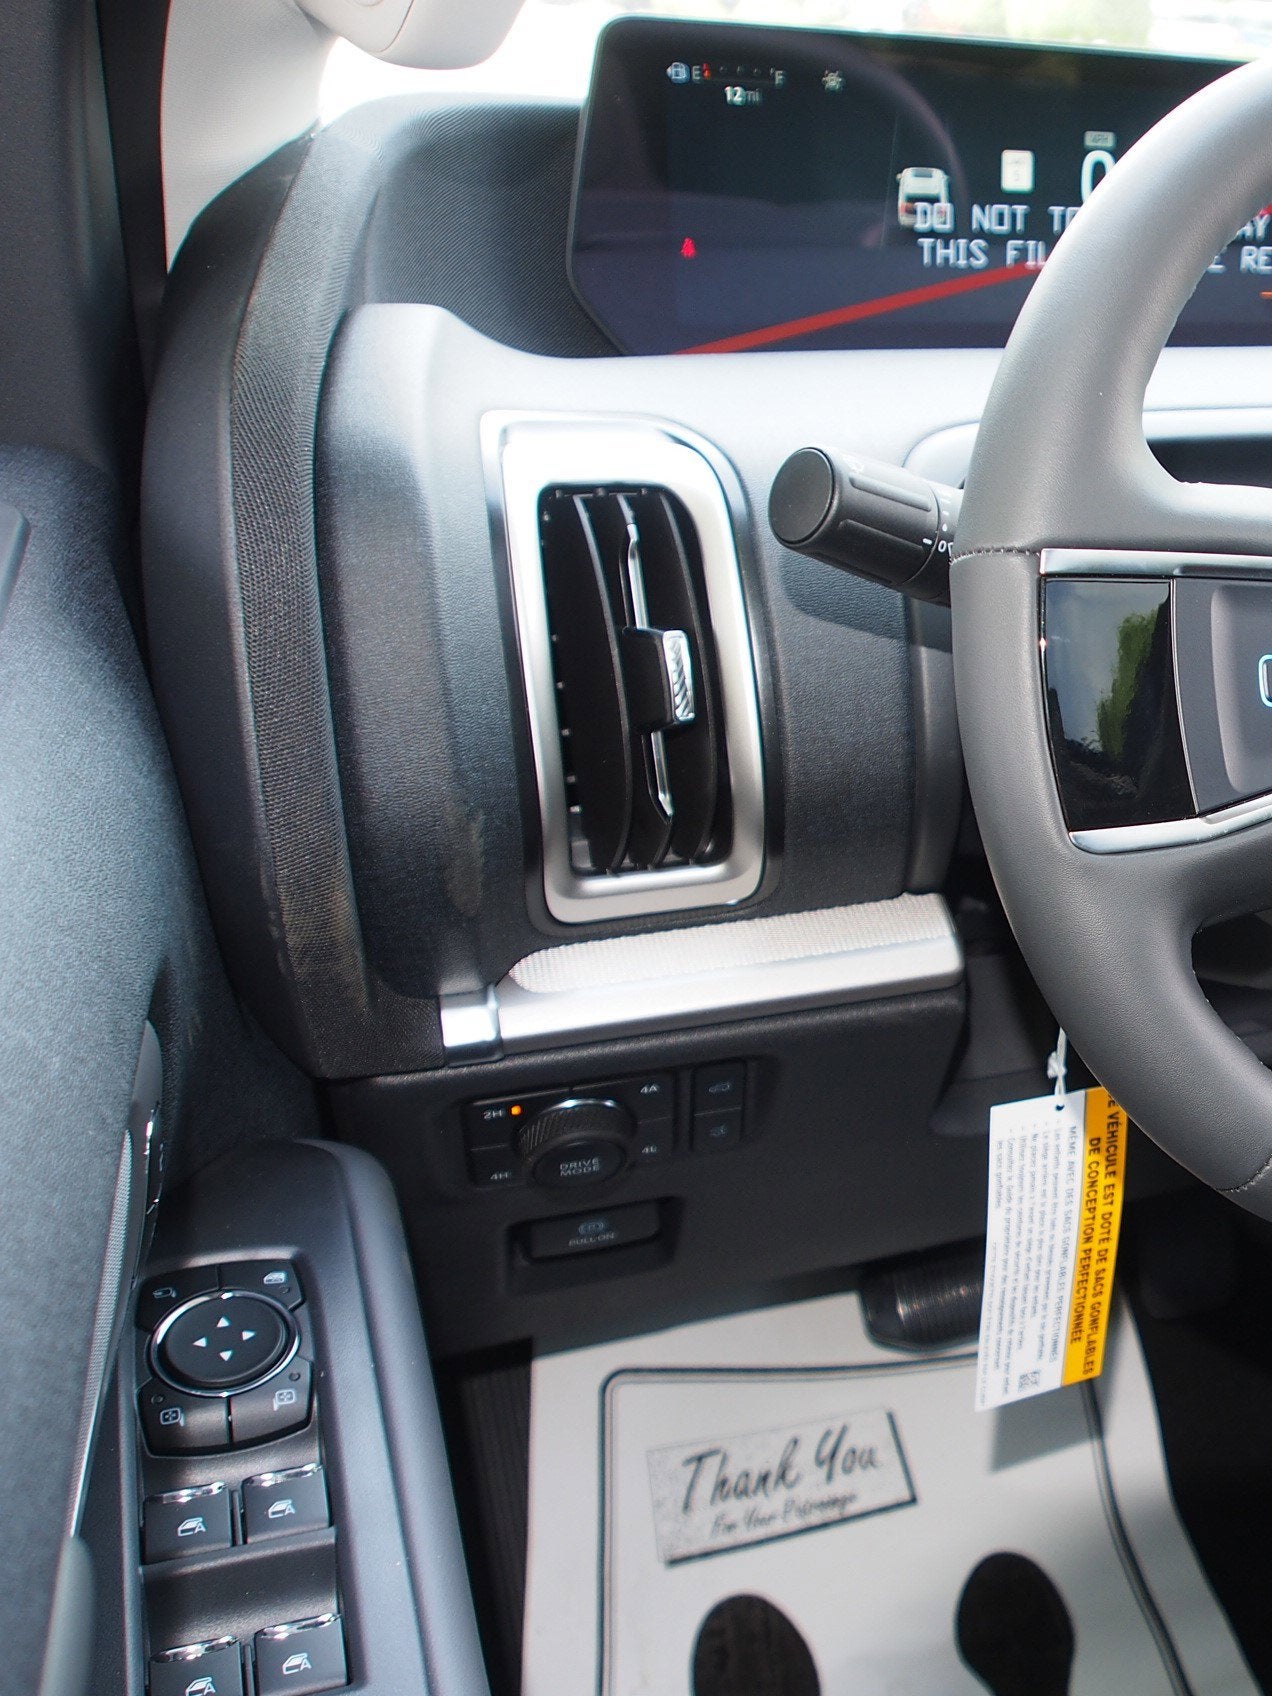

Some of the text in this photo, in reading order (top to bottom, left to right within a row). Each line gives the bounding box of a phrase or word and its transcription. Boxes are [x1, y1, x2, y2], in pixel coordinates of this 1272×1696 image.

[915, 203, 953, 232] DO
[972, 204, 1029, 233] NOT
[918, 239, 988, 269] THIS
[483, 1109, 504, 1120] 2H
[1104, 1112, 1122, 1179] VÉHICULE
[490, 1171, 511, 1181] 4H
[559, 1157, 600, 1171] DRIVE
[560, 1165, 600, 1178] MODE
[1065, 1161, 1075, 1185] AVEC
[1064, 1188, 1074, 1206] DES
[1102, 1184, 1115, 1206] EST
[1063, 1210, 1073, 1234] SACS
[1098, 1212, 1113, 1245] DOTÉ
[1070, 1138, 1101, 1344] DE CONCEPTION PERFECTIONNÉE
[1096, 1249, 1108, 1265] DE
[1092, 1269, 1106, 1298] SACS
[1082, 1302, 1102, 1375] GONFLABLES
[682, 1424, 880, 1515] Thank You
